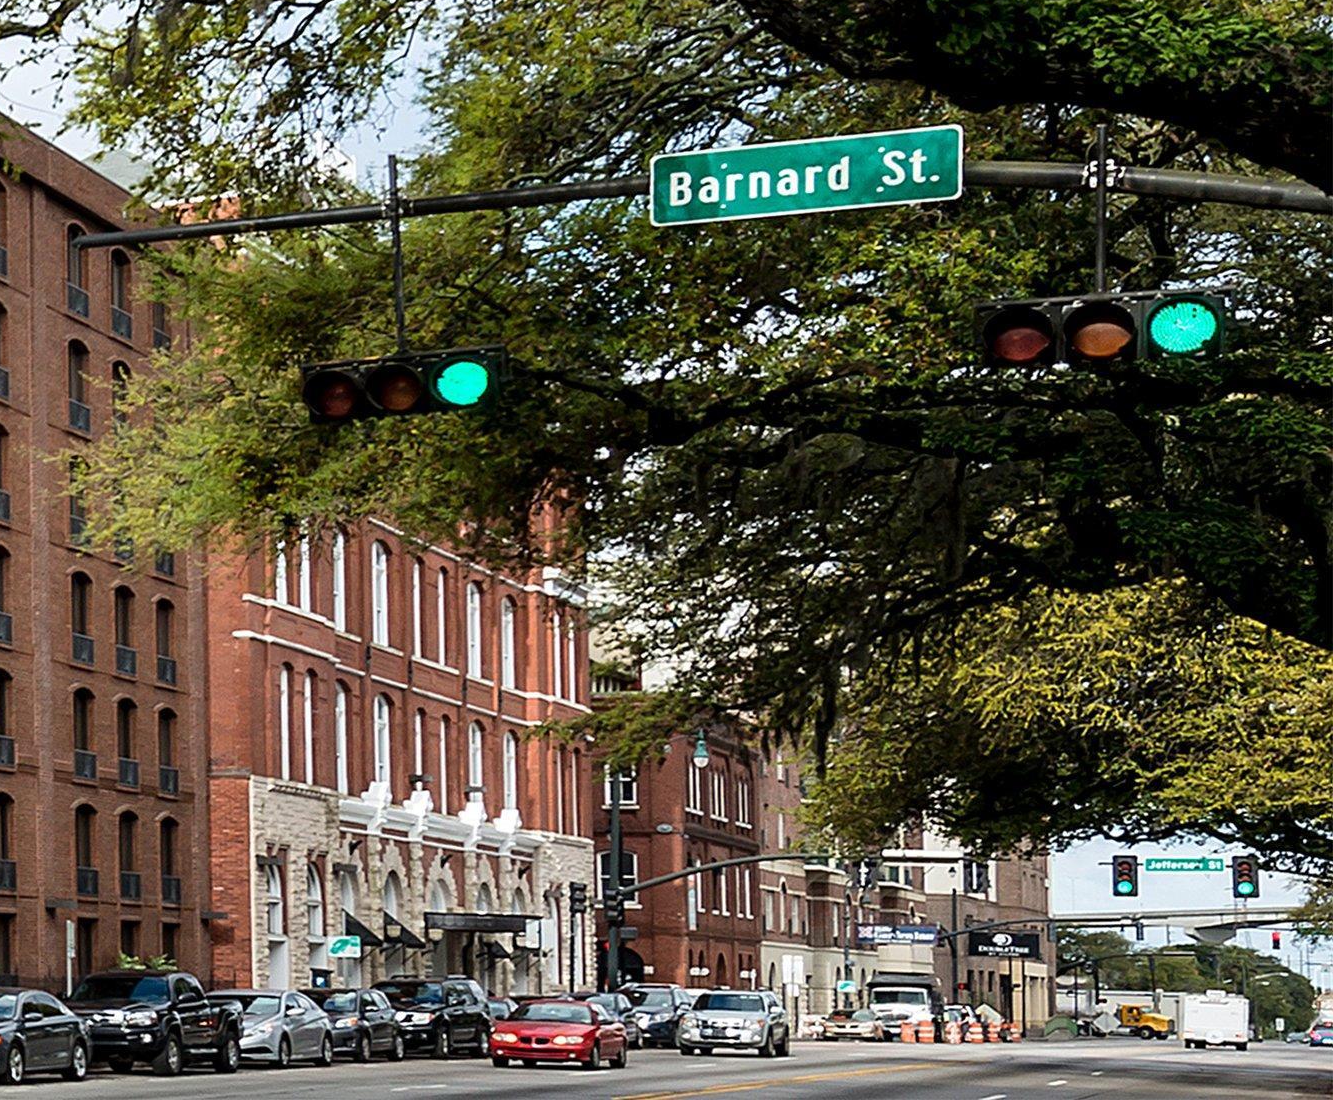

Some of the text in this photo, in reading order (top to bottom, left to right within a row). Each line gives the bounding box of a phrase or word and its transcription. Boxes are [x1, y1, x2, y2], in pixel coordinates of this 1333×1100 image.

[669, 148, 940, 207] Barnard St.
[1208, 860, 1222, 870] St
